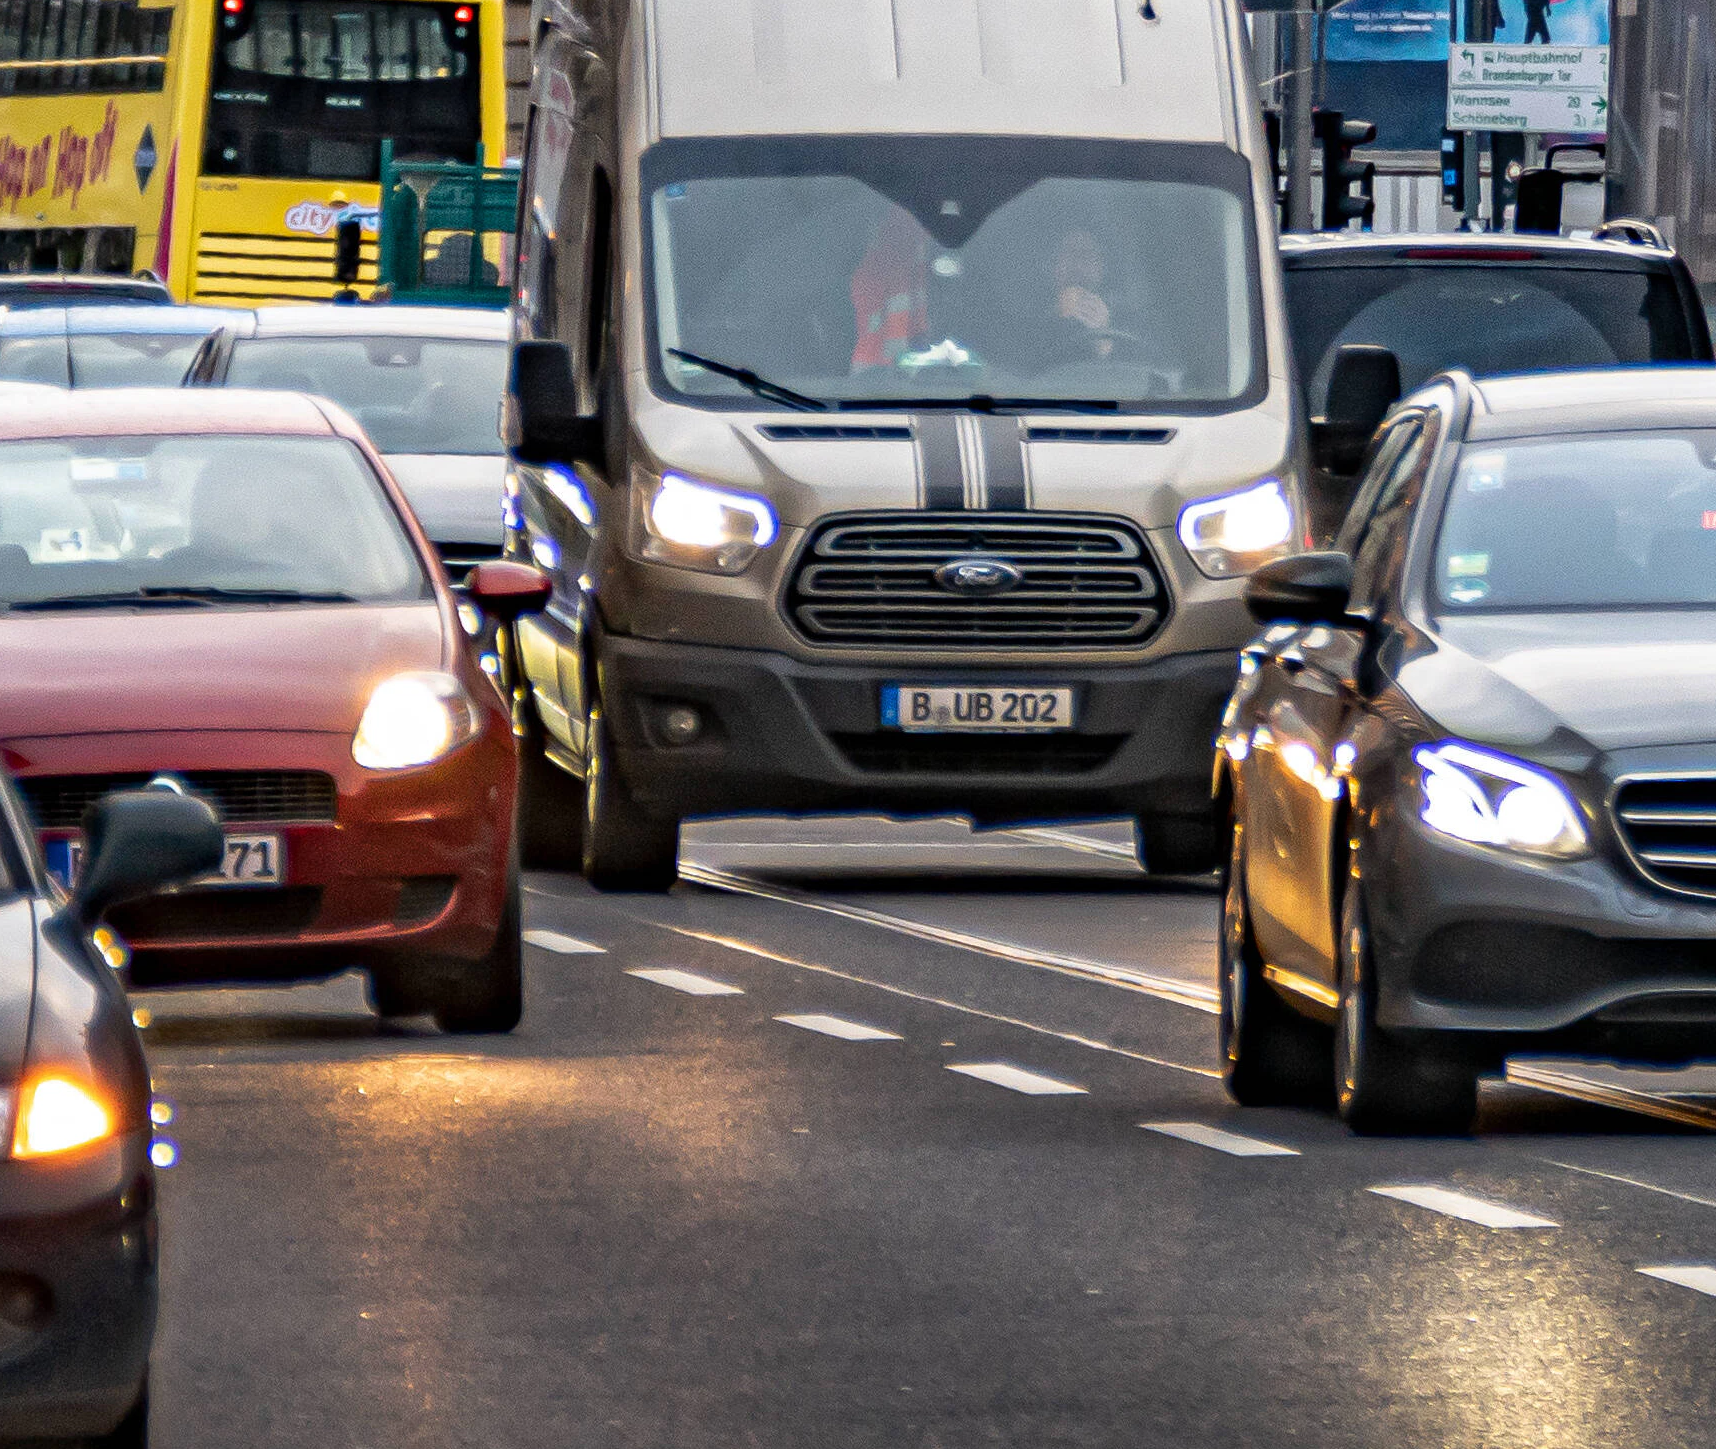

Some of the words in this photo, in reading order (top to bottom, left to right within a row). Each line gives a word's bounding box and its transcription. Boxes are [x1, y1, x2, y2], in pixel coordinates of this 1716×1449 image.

[1497, 51, 1582, 64] Hauptbahnhof
[1483, 69, 1553, 84] Brandenburger
[1453, 95, 1510, 106] Wannsee
[1453, 112, 1528, 127] Schöneberg
[289, 208, 333, 230] city
[912, 691, 931, 721] B
[954, 692, 994, 722] UB
[1001, 692, 1058, 723] 202
[221, 841, 273, 878] 71
